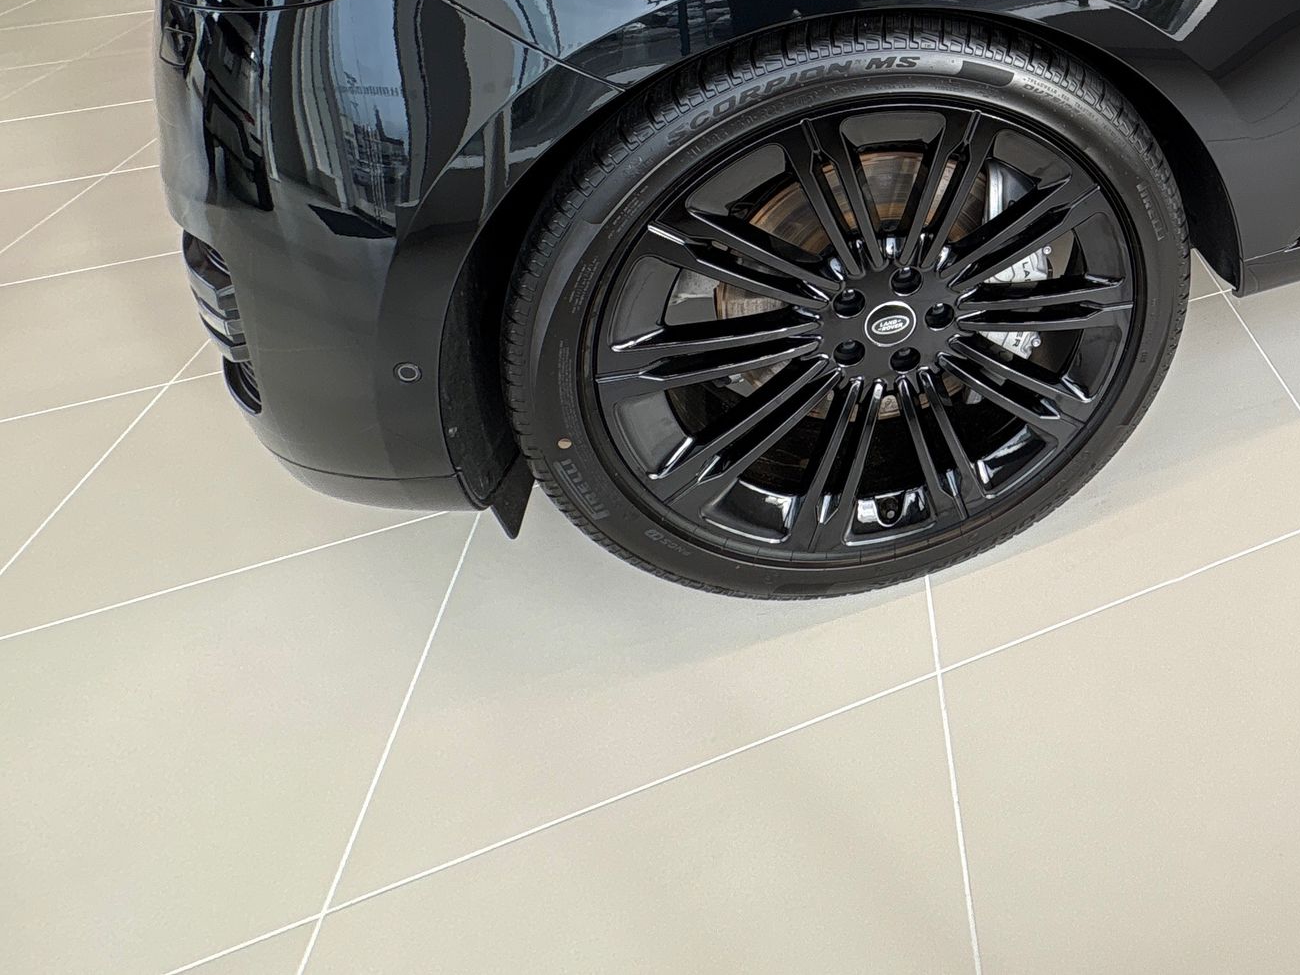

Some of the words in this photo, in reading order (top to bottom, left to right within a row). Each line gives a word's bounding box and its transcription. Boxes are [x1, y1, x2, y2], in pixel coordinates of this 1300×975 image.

[667, 60, 853, 146] SCORPION
[865, 56, 921, 70] MS
[553, 459, 610, 519] PIRELLI
